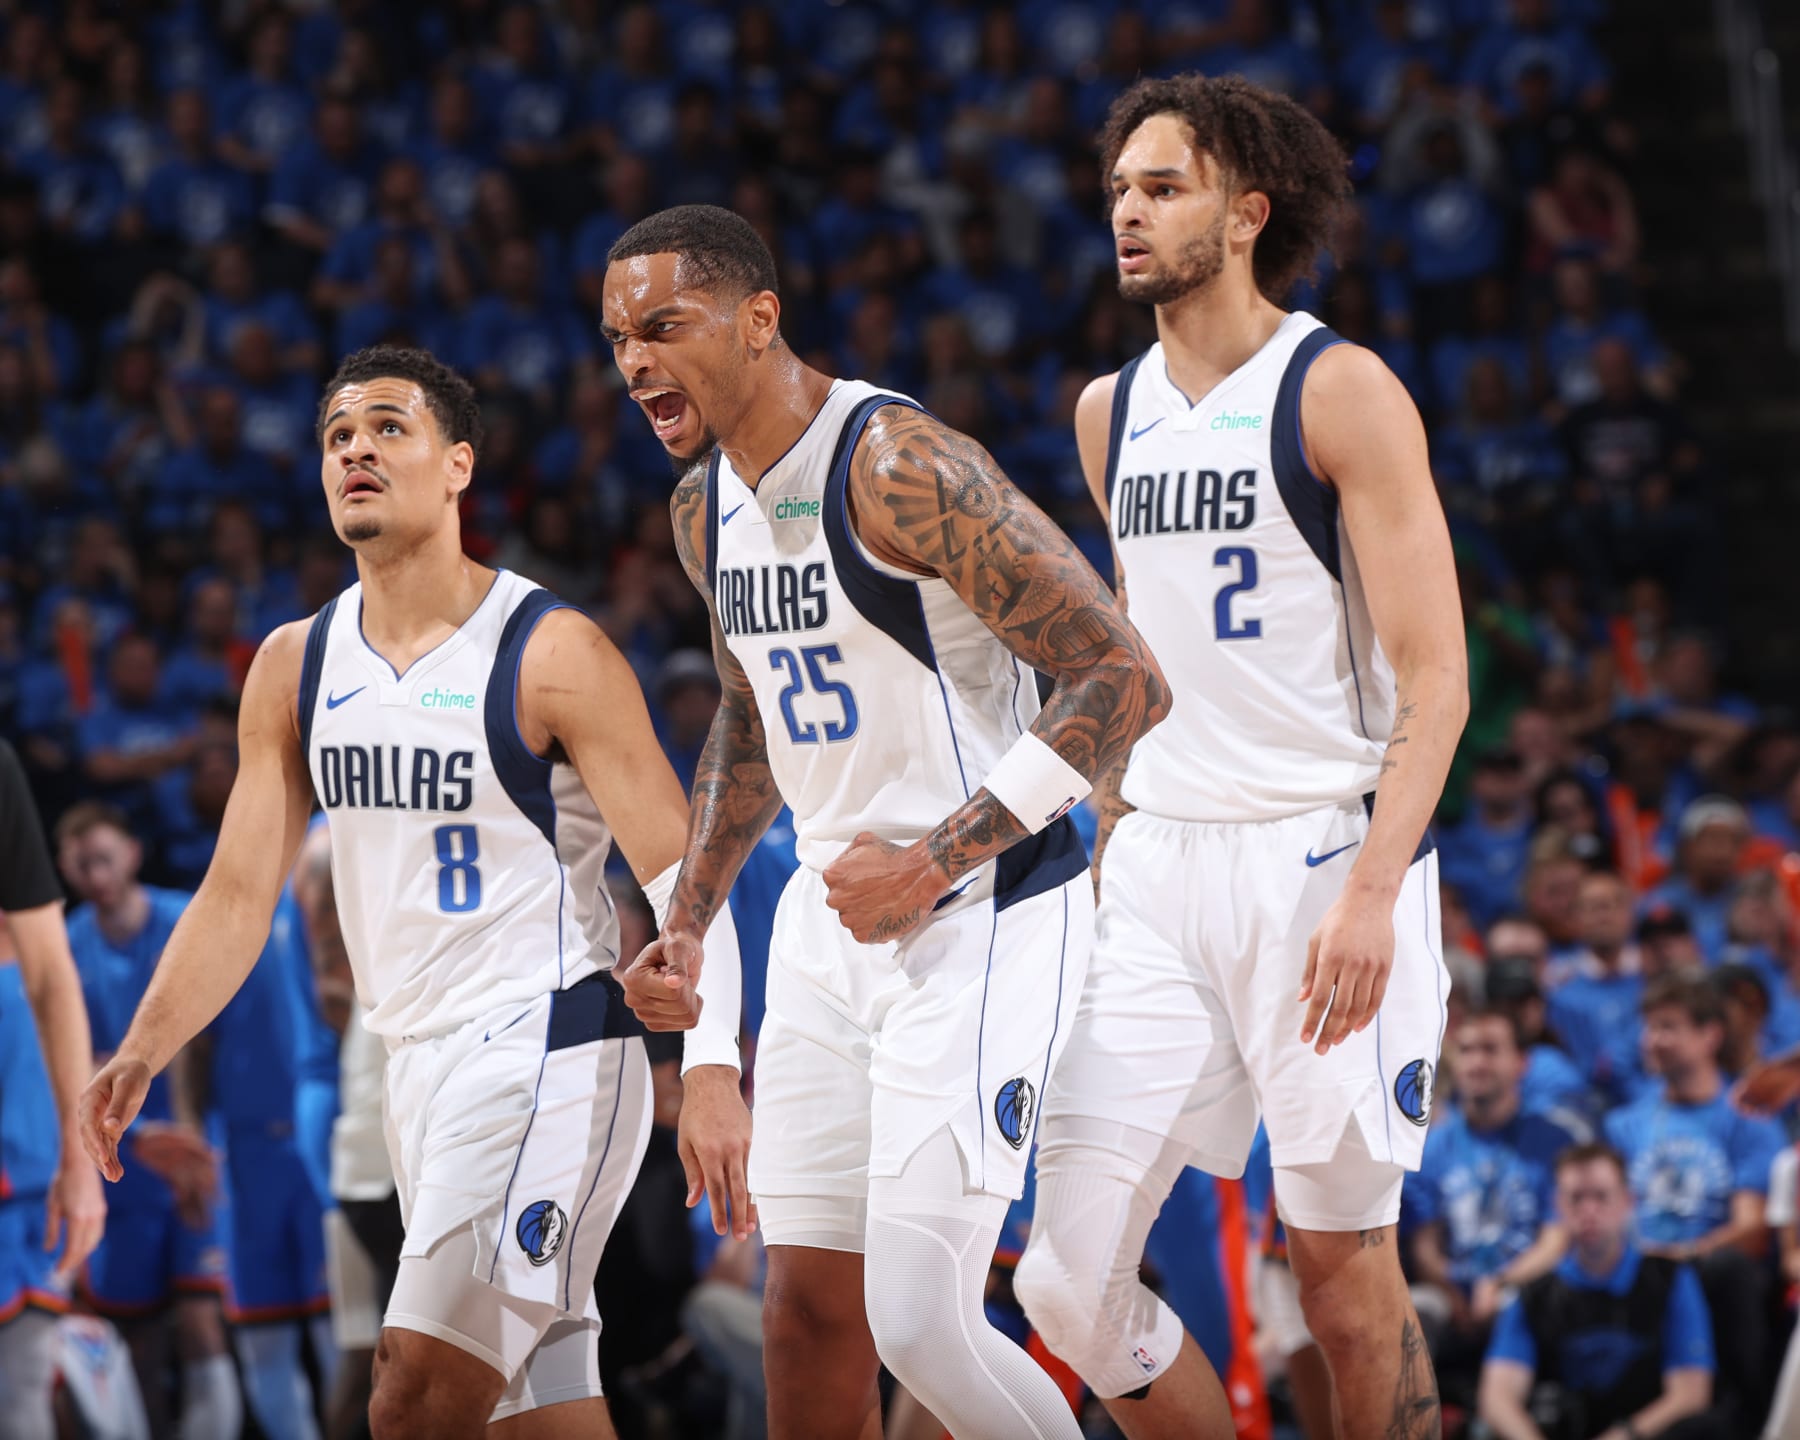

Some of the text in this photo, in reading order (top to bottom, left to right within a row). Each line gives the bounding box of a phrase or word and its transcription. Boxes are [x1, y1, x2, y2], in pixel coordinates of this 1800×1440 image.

[1211, 410, 1263, 430] chime
[775, 496, 820, 519] chime
[1118, 469, 1258, 540] DALLAS
[718, 560, 830, 636] DALLAS
[1213, 545, 1263, 641] 2
[421, 687, 476, 709] chime
[768, 641, 860, 745] 25
[320, 744, 475, 813] DALLAS
[432, 823, 482, 914] 8
